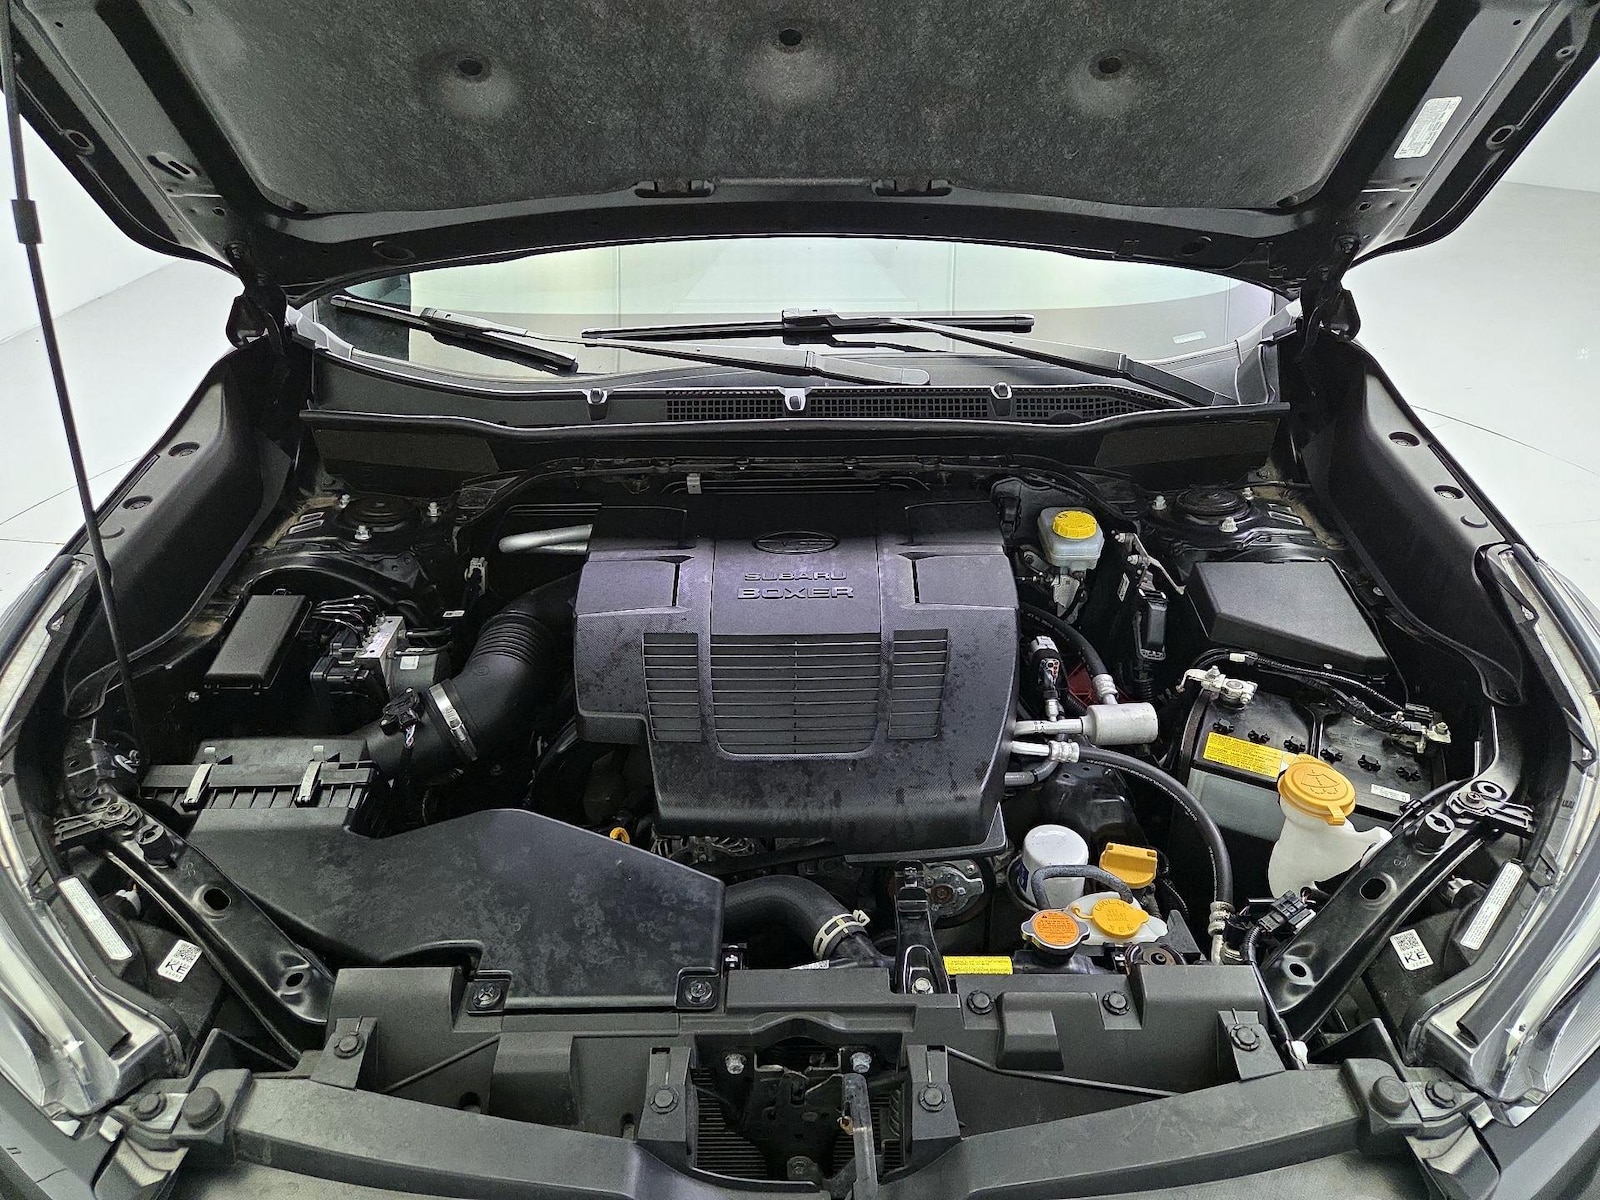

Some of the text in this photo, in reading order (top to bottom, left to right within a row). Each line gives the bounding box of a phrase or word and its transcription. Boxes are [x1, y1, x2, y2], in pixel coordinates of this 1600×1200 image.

[744, 571, 847, 581] SUBARU
[737, 586, 854, 599] BOXER
[1403, 951, 1427, 964] KE
[165, 961, 188, 974] KE
